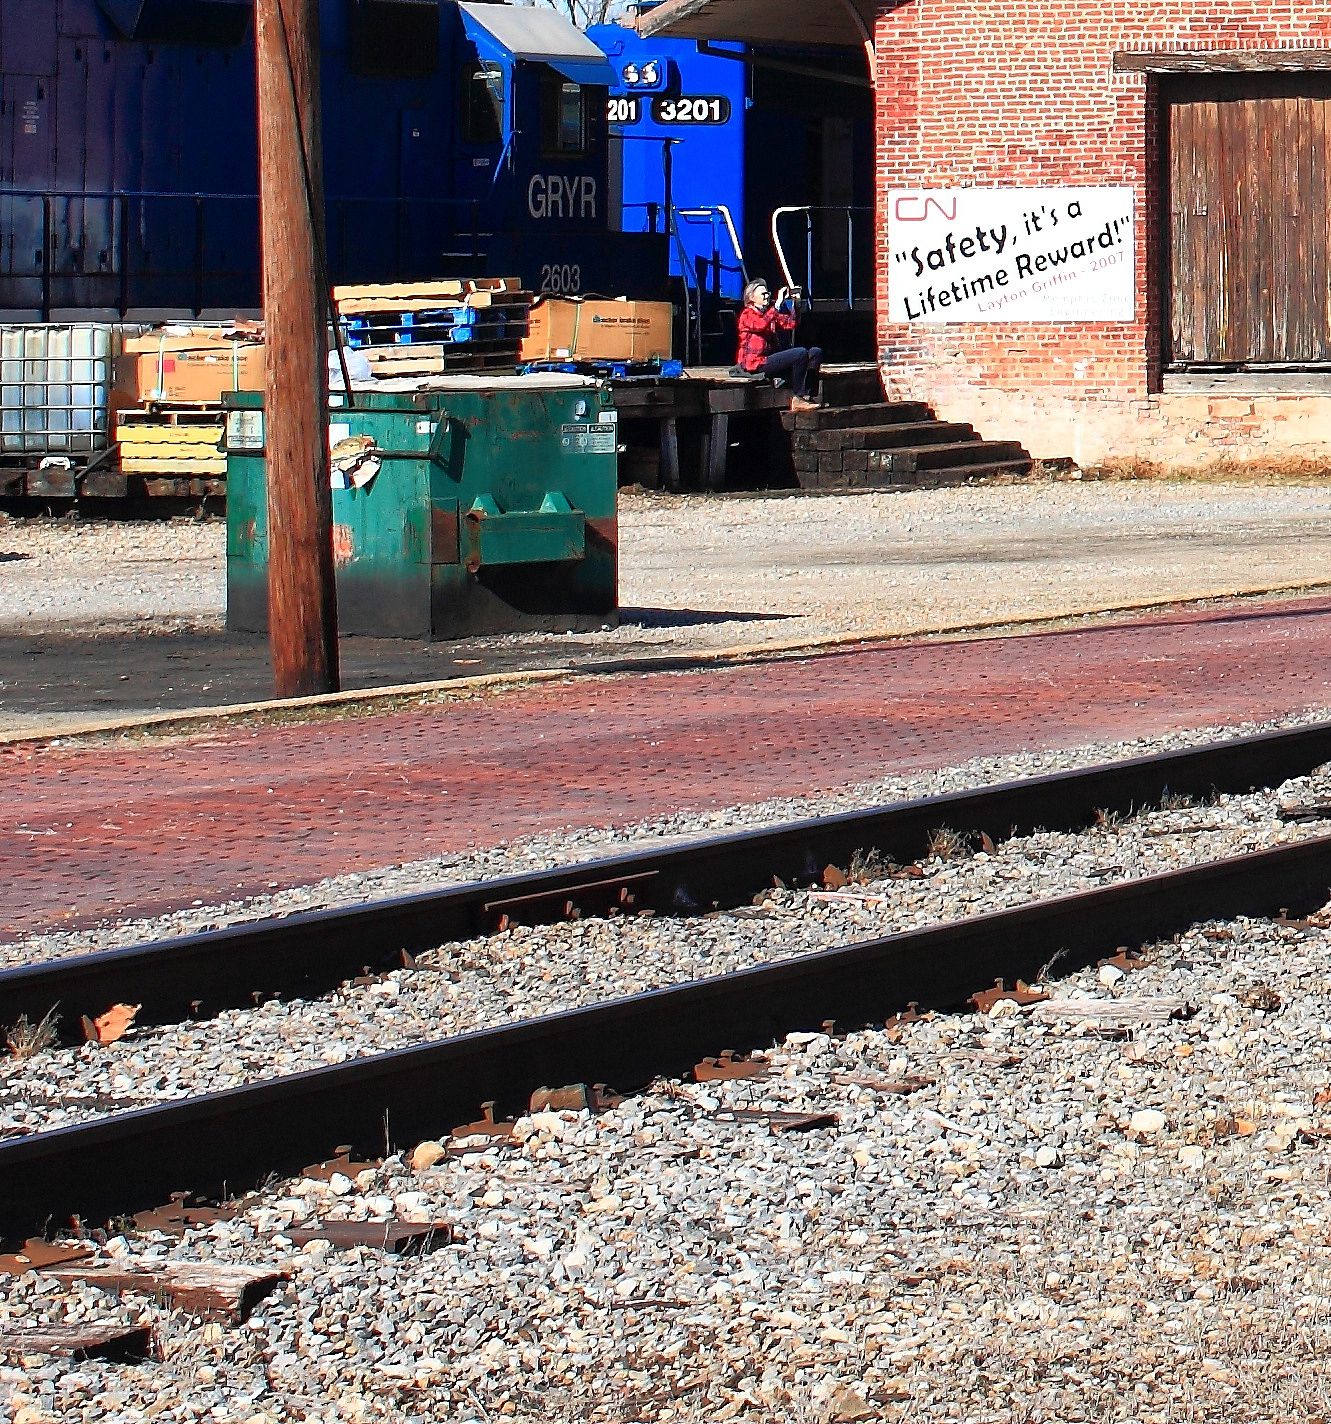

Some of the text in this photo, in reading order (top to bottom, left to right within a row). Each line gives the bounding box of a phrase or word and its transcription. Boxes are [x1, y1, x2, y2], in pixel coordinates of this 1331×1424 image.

[608, 99, 636, 121] 201
[660, 99, 720, 121] 3201
[528, 174, 596, 219] GRYR
[895, 197, 957, 221] CN
[895, 201, 1082, 277] "Safety, it's a
[541, 264, 581, 292] 2603
[904, 216, 1130, 320] Lifetime Reward!"
[978, 289, 1027, 313] Layton
[1032, 272, 1077, 293] Griffin
[1090, 252, 1124, 272] 2007
